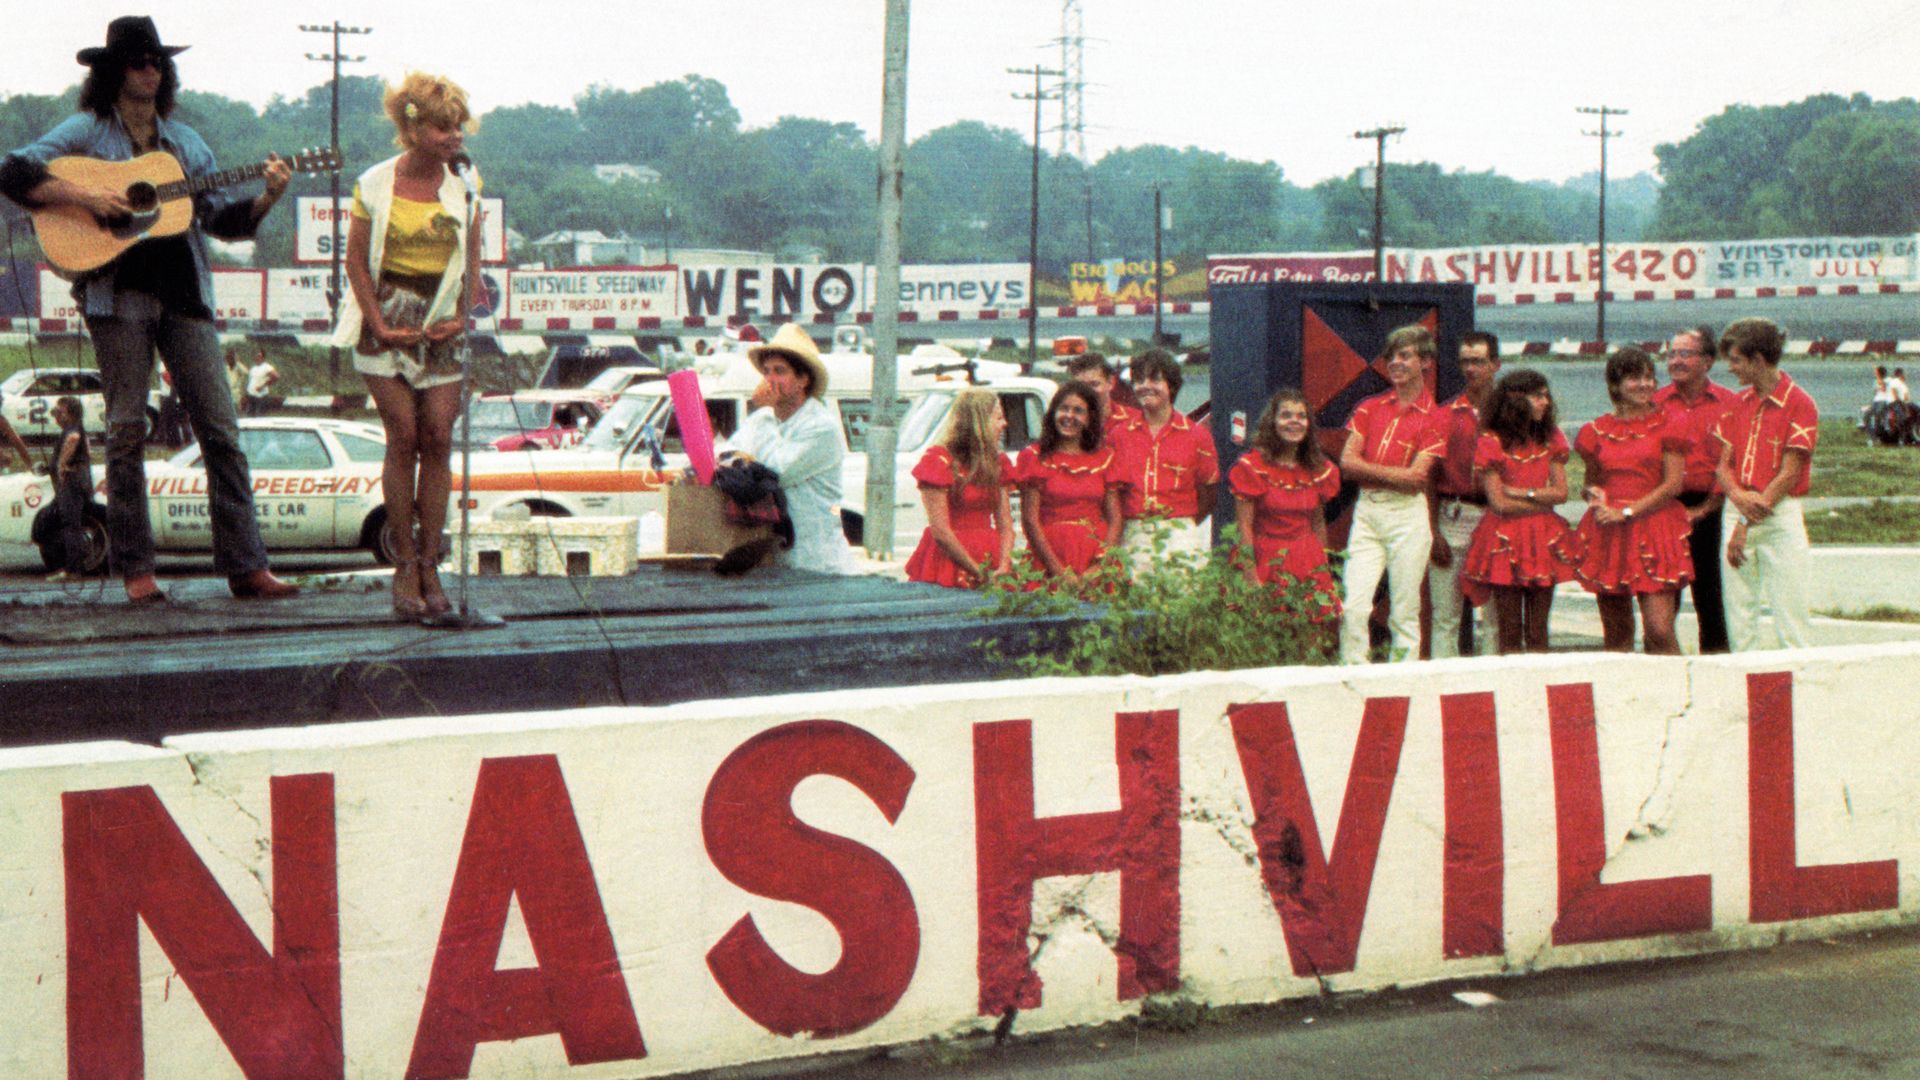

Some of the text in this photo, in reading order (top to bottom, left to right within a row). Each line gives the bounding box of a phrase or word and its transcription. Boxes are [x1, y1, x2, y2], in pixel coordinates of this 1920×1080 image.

[1720, 243, 1832, 260] WINSTON
[1838, 240, 1881, 258] CUP
[1386, 249, 1601, 285] NASHVILLE
[1718, 258, 1882, 279] SAT. JULY
[596, 275, 667, 294] SPEEDWAY
[683, 266, 855, 316] WENO
[898, 280, 1025, 307] enneys
[520, 299, 556, 312] EVERY
[168, 502, 211, 517] OFFIC
[277, 502, 306, 516] CAR
[62, 671, 1899, 1080] NASHVILL
